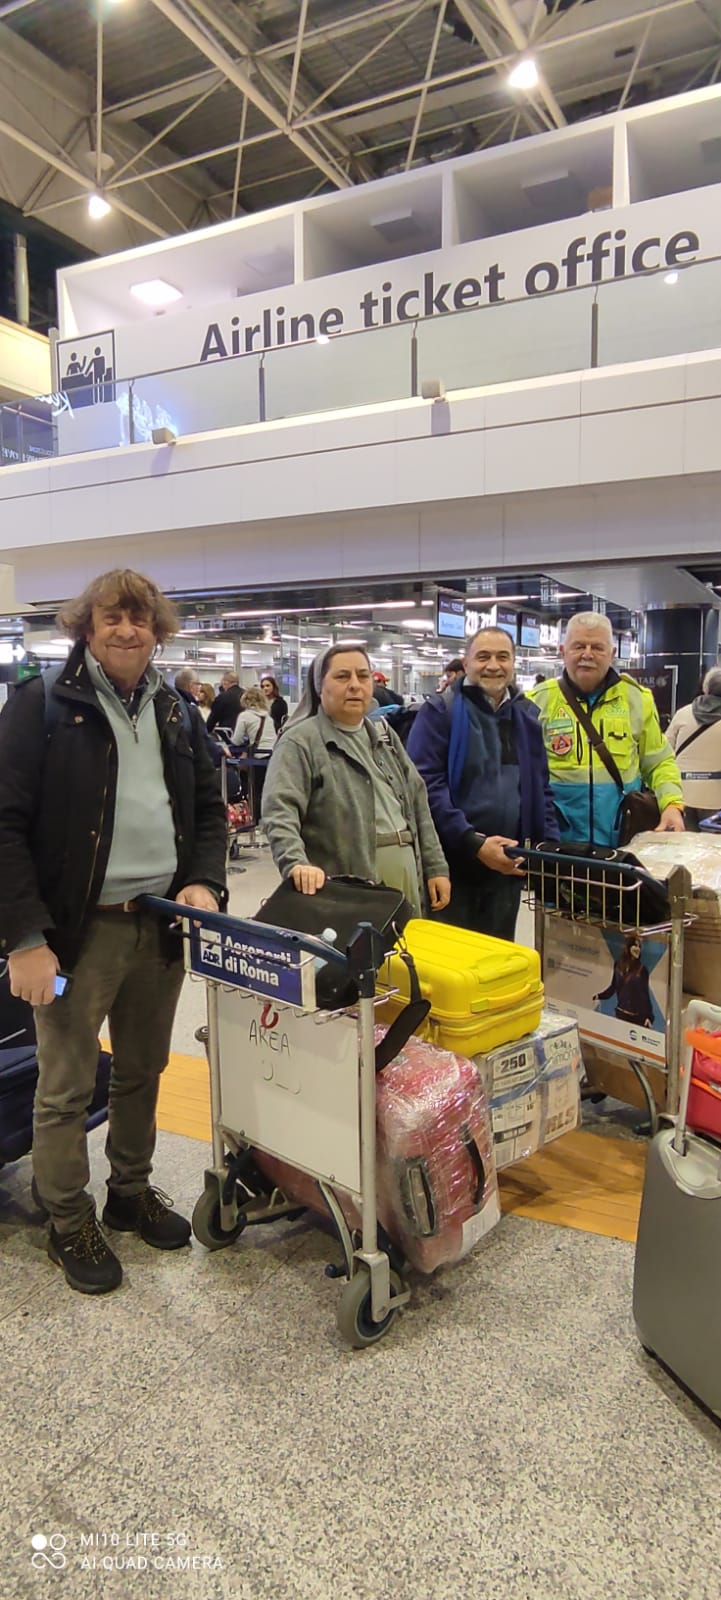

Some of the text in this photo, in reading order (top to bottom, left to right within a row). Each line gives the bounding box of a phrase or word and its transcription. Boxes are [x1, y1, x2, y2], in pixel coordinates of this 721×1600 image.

[200, 229, 700, 362] Airline ticket office
[225, 956, 279, 987] di Roma
[249, 1019, 291, 1057] AREA
[500, 1053, 526, 1072] 250
